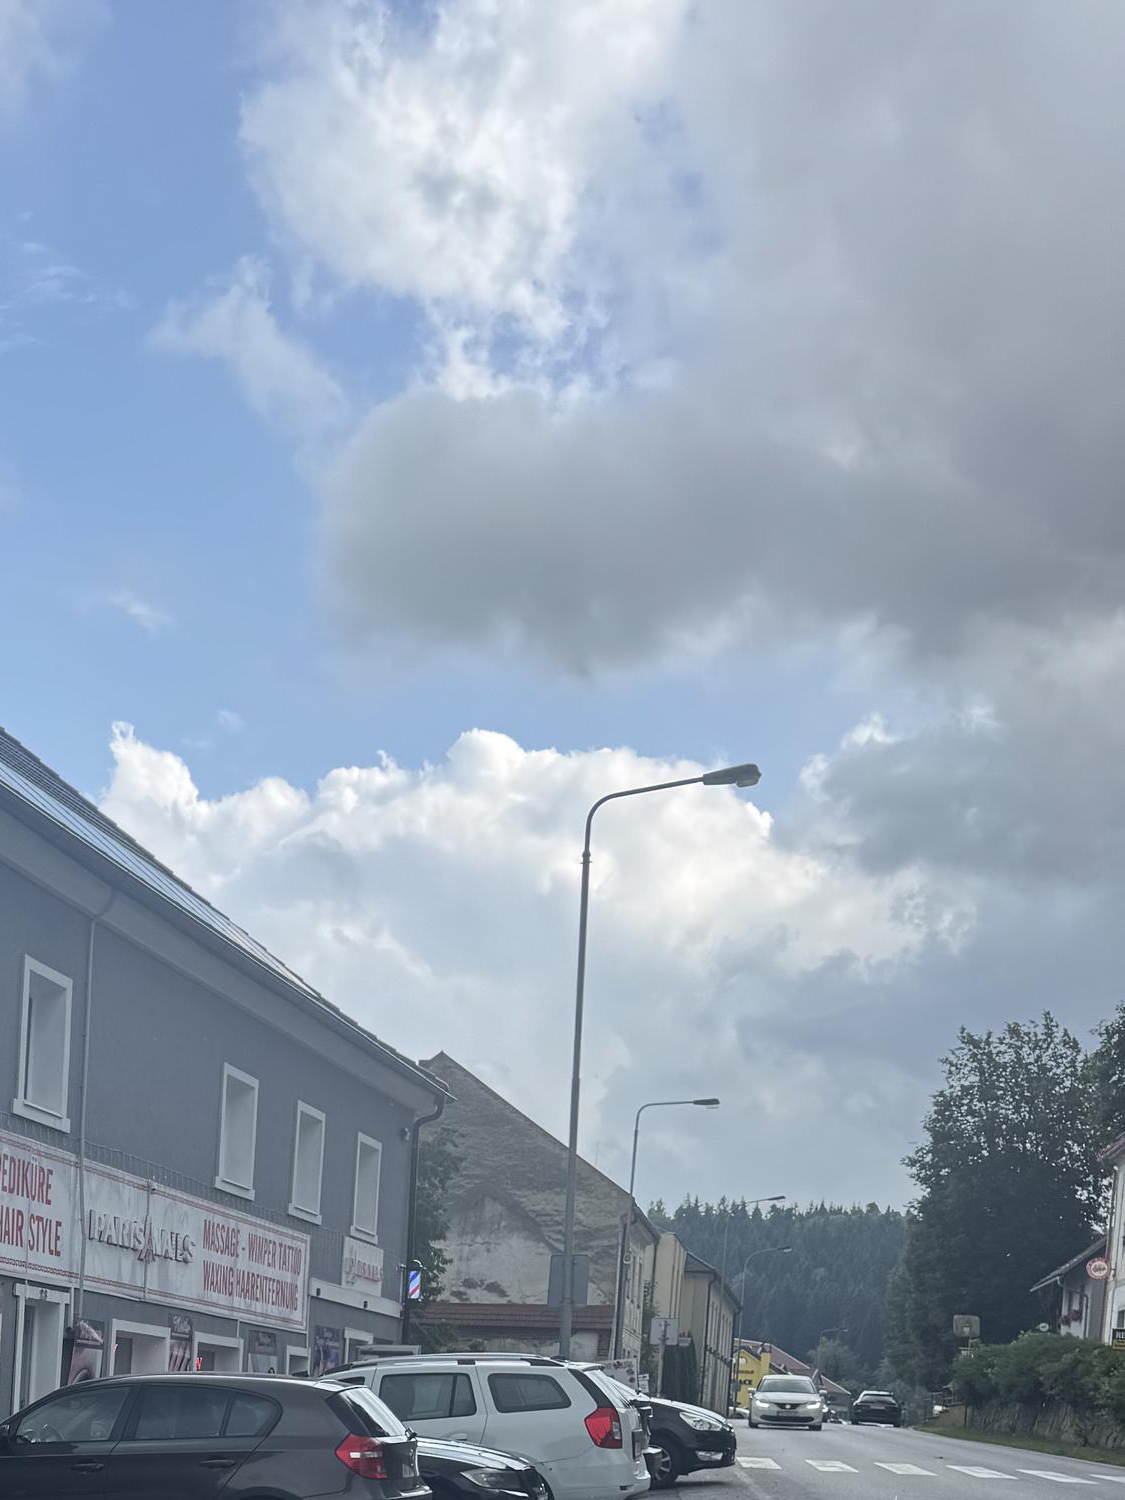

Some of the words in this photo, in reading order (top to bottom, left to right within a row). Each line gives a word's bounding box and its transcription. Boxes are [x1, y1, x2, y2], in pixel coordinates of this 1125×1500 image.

[28, 1214, 62, 1257] STYLE
[203, 1219, 240, 1258] MASSAGE
[203, 1260, 234, 1297] WAXING
[236, 1269, 299, 1311] HAARENTFERNUNG
